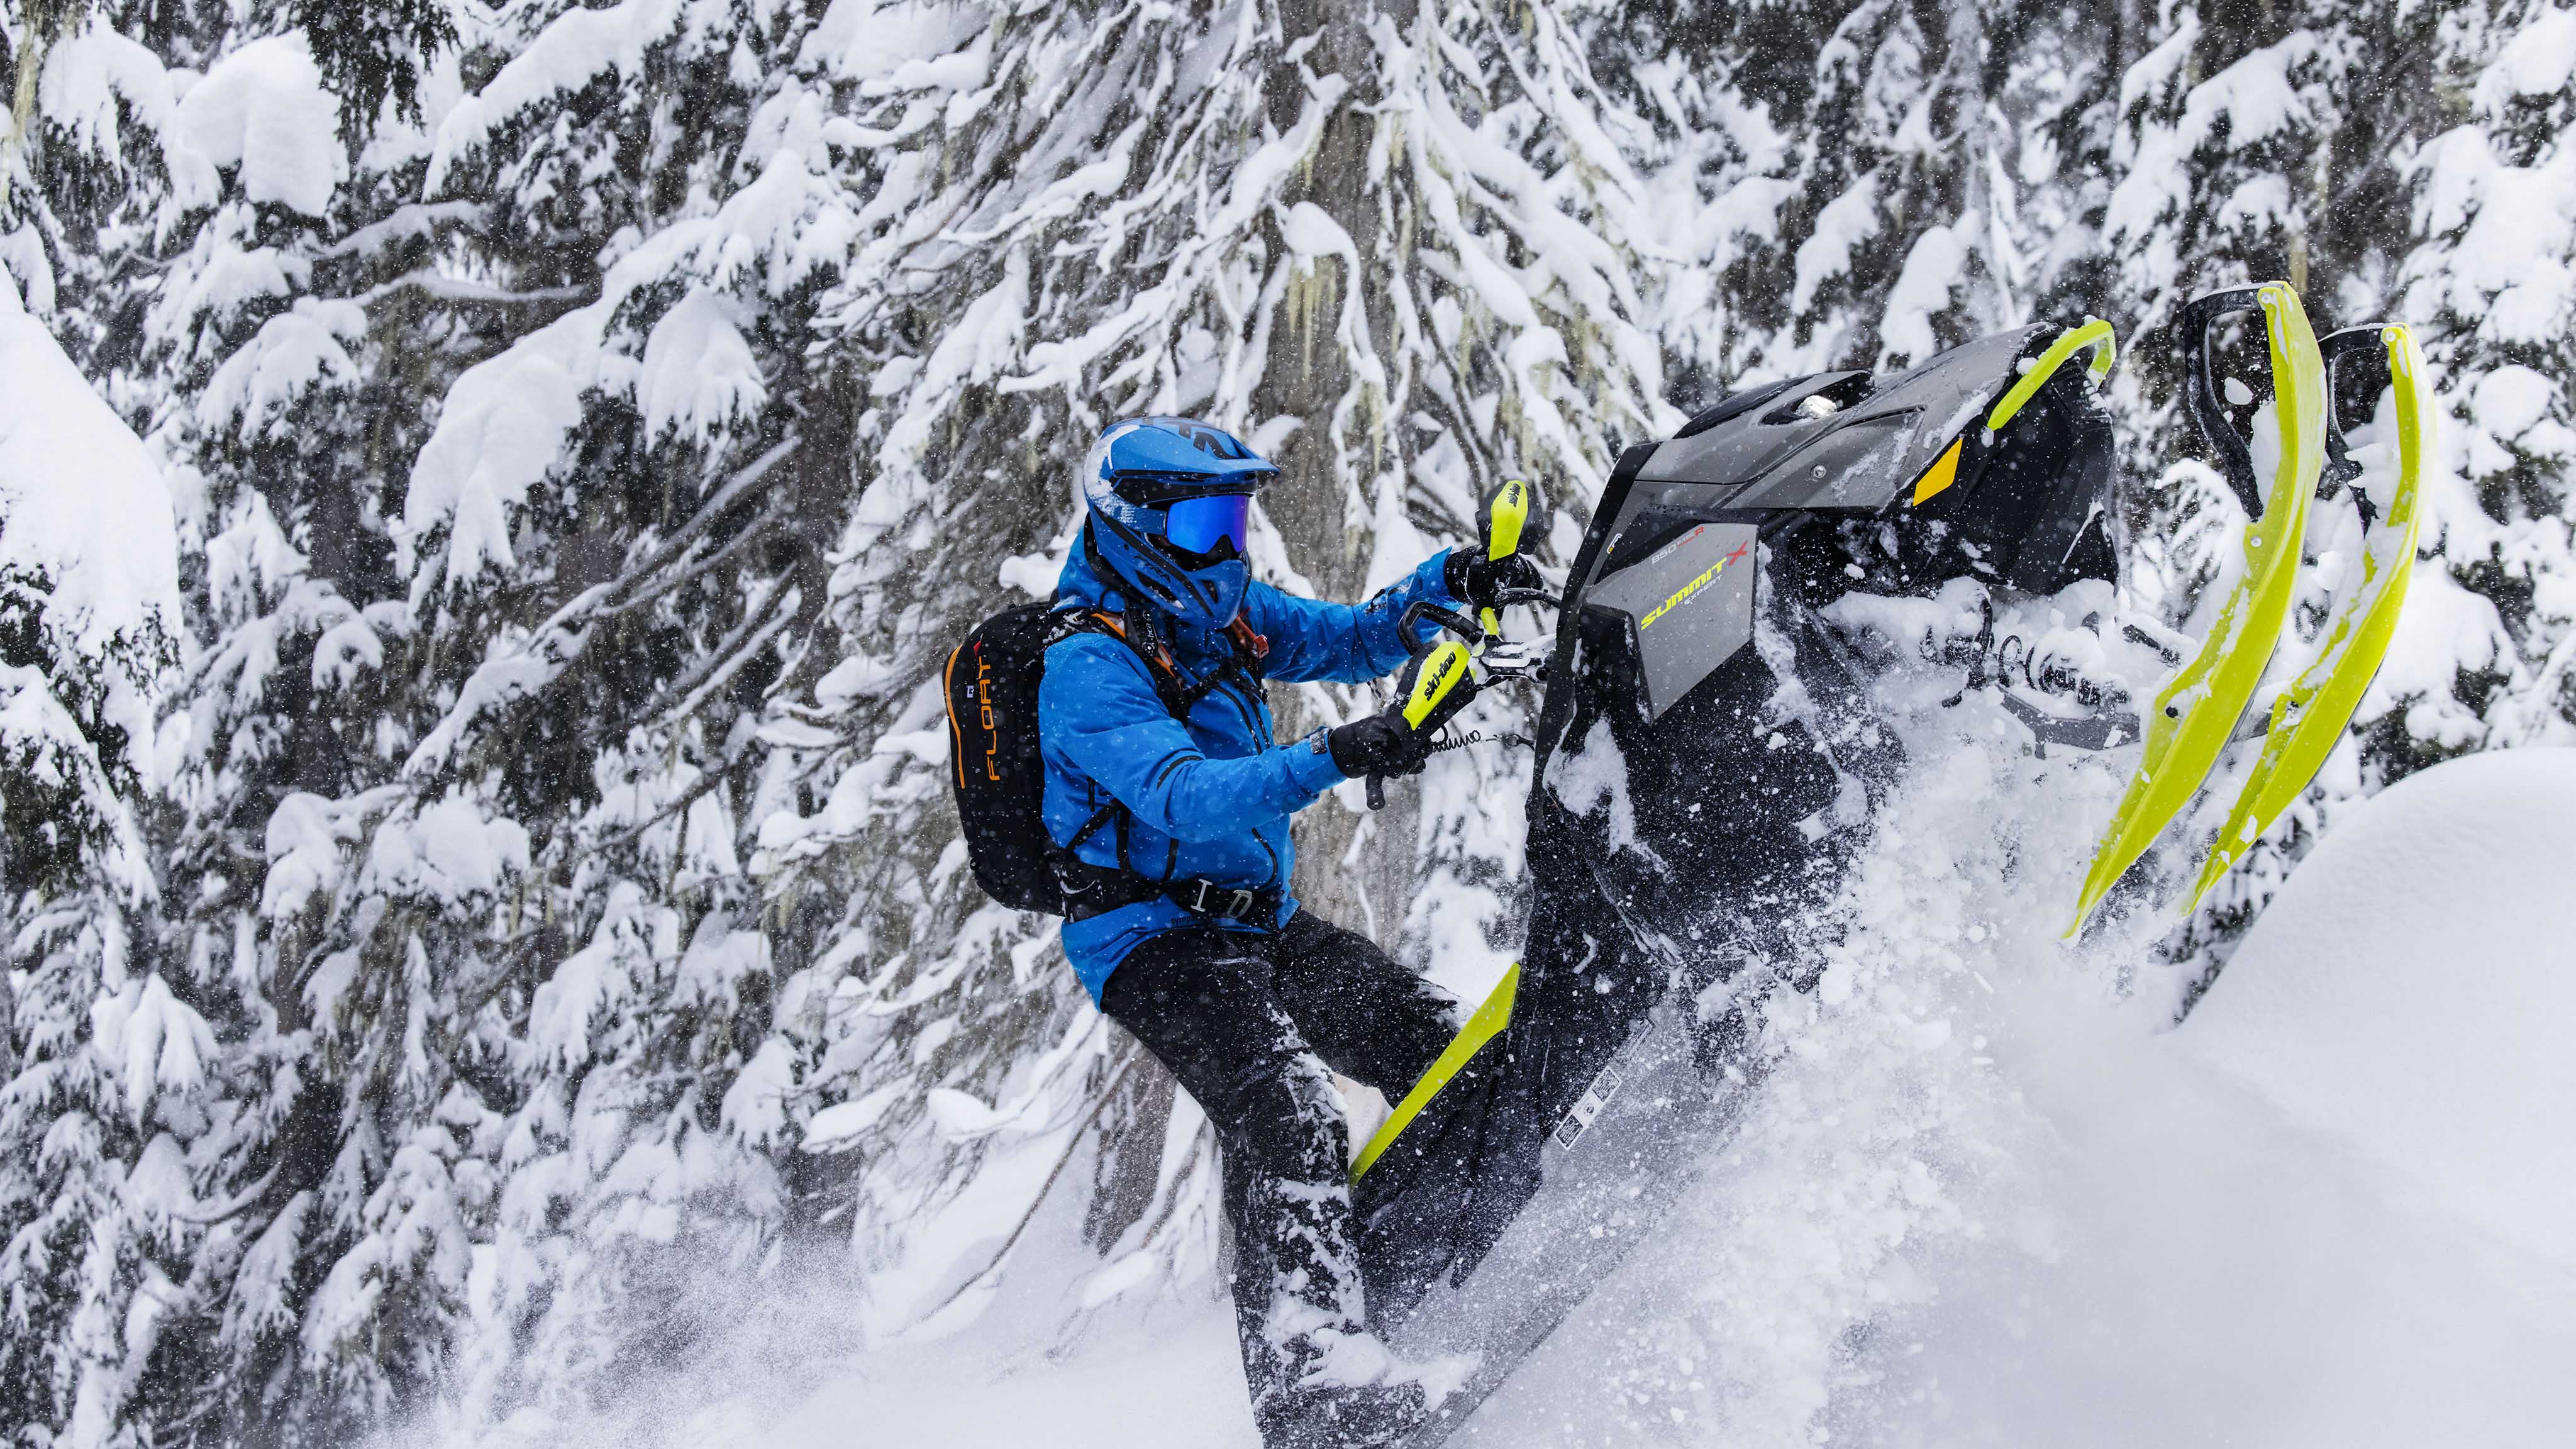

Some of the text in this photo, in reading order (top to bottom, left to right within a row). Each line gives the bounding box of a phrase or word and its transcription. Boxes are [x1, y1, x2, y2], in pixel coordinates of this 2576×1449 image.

[1652, 526, 1705, 564] 850 R
[1641, 557, 1727, 630] SUMMIT
[1684, 574, 1723, 605] EXPERT
[1424, 651, 1456, 701] ski-doo
[978, 655, 1001, 780] FLOAT
